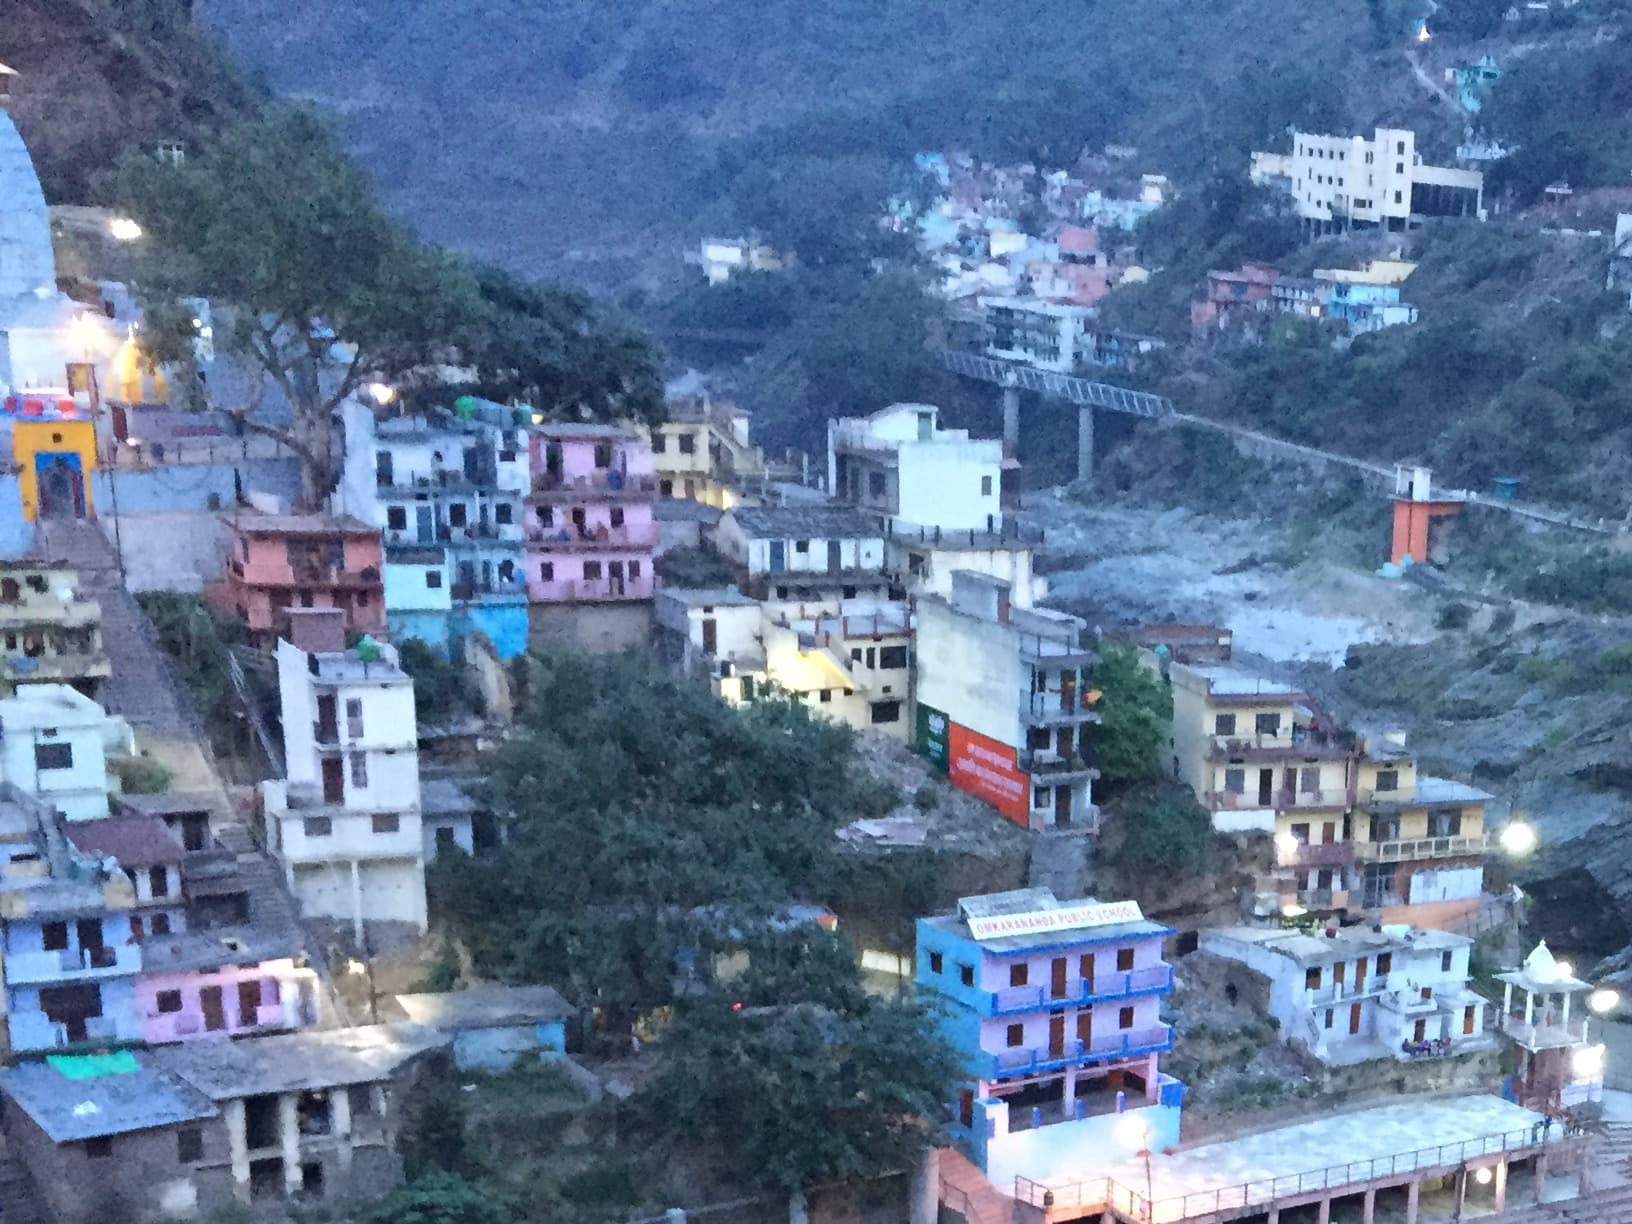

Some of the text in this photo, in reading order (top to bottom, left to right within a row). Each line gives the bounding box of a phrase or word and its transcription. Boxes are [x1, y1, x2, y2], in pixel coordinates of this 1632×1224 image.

[976, 905, 1137, 934] OMKARANANDA PUBLIC SCHOOL
